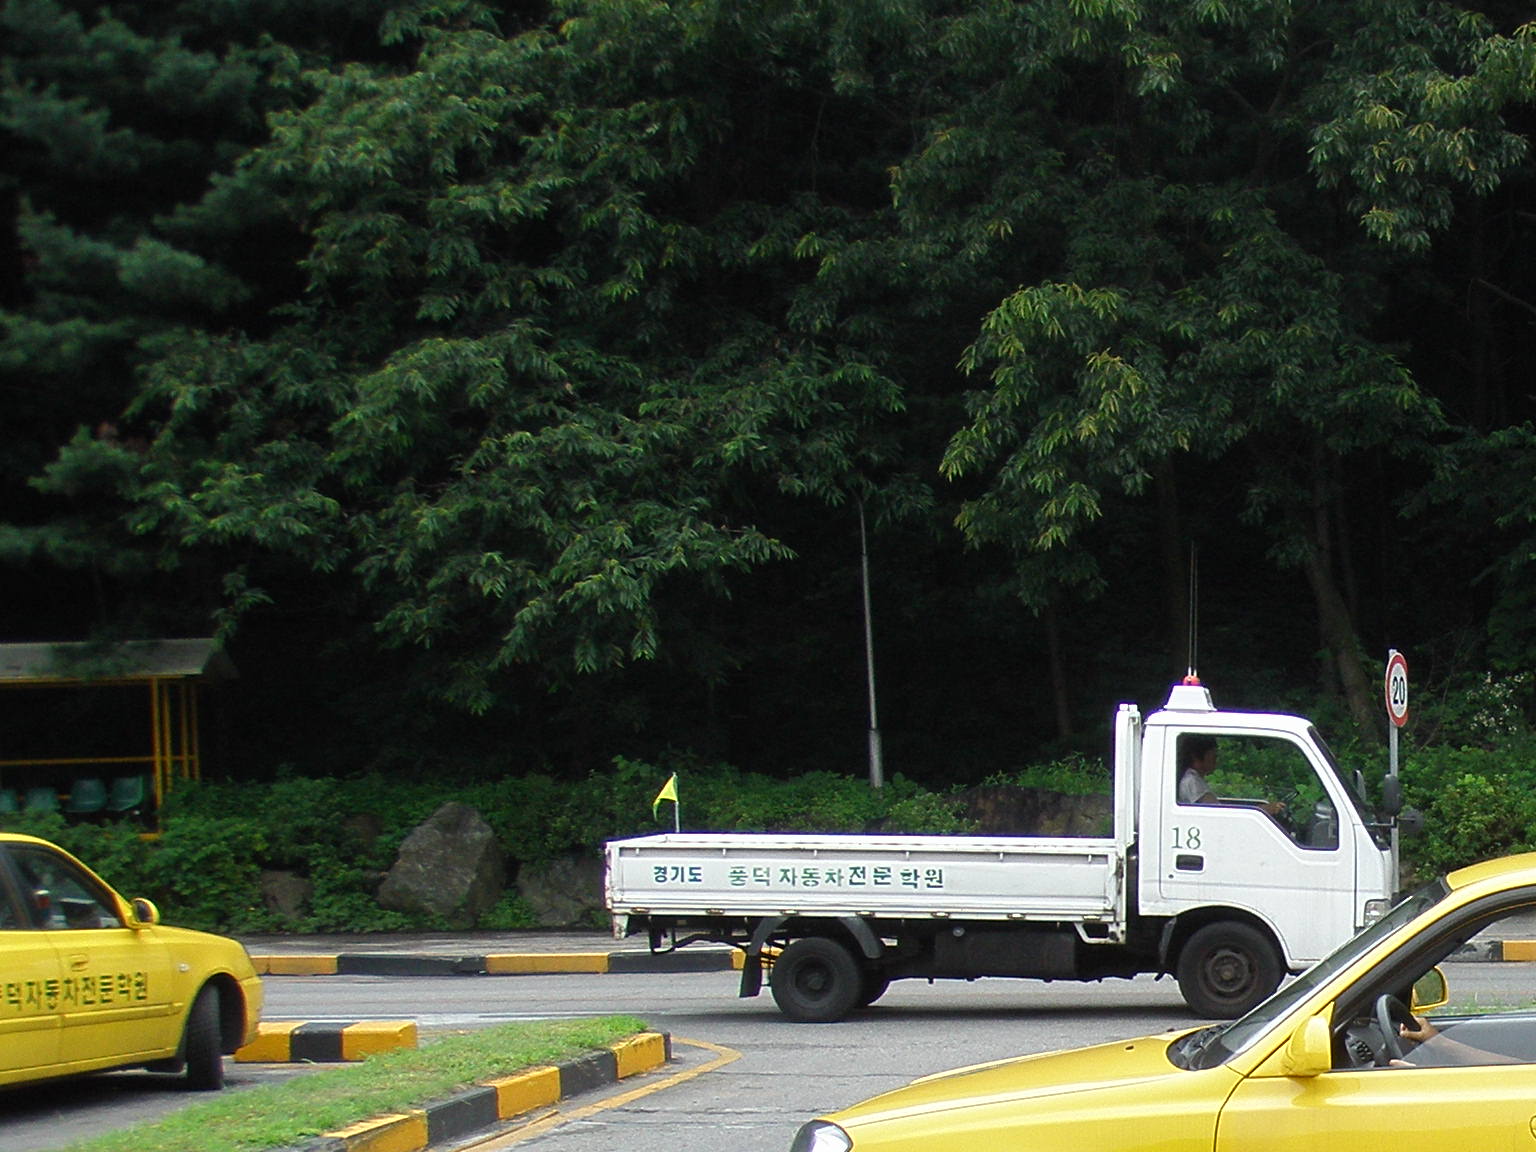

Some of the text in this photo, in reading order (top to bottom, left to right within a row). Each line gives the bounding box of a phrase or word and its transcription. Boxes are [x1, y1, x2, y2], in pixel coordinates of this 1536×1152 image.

[1392, 676, 1406, 705] 20
[1171, 826, 1201, 850] 18
[653, 866, 703, 883] 경기도
[0, 972, 148, 1012] 덕자동차전문학원
